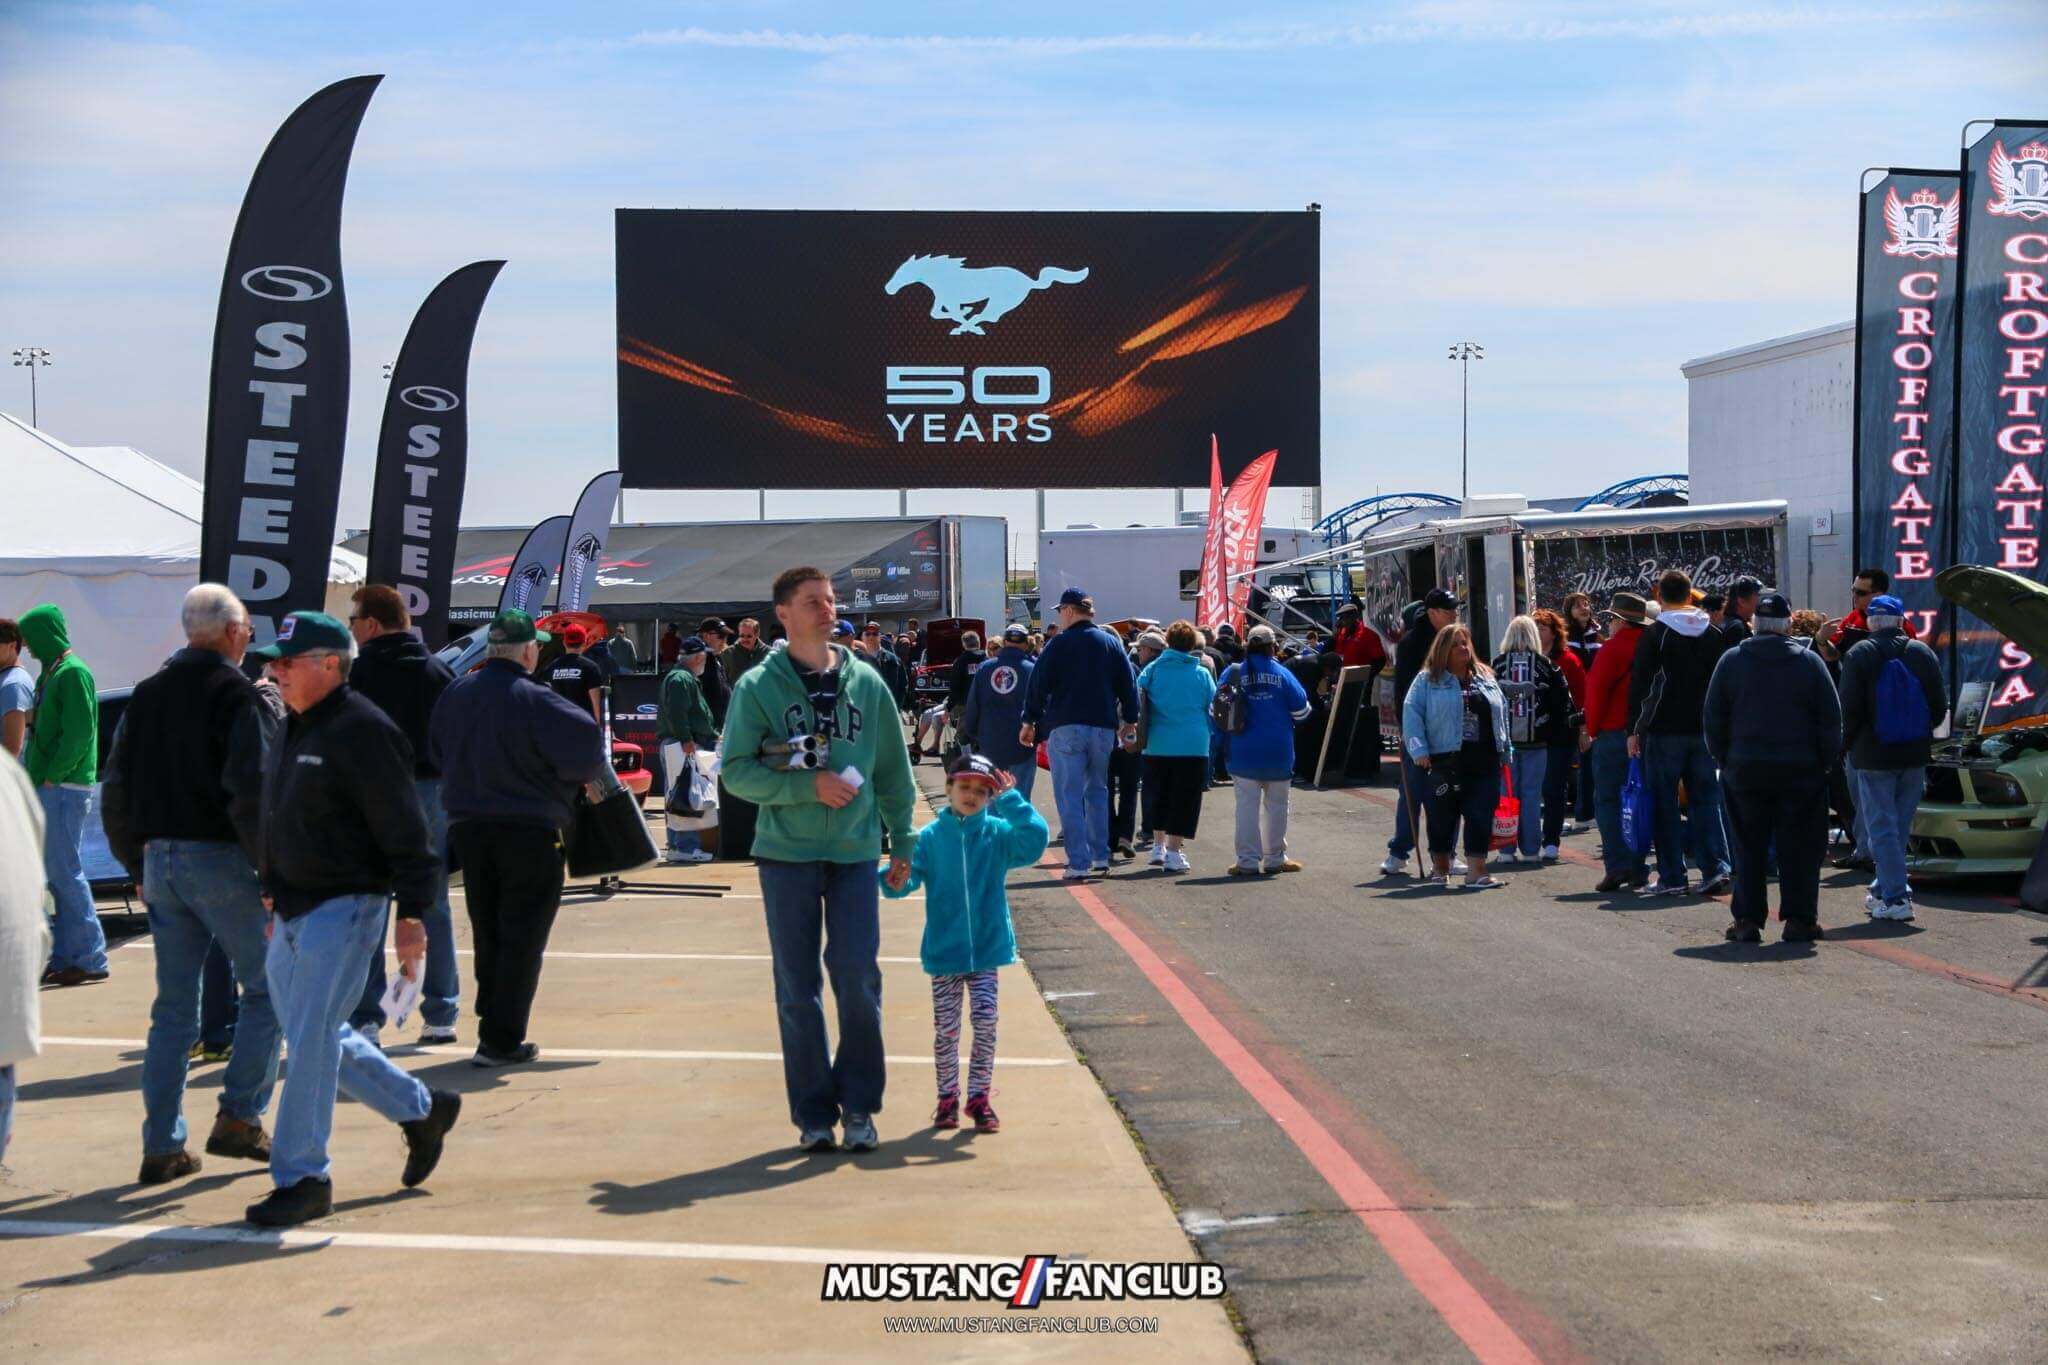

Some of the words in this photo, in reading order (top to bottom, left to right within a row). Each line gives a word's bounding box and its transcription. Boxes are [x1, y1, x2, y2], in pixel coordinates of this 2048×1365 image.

[886, 366, 1051, 405] 50
[1996, 233, 2048, 569] CROFTGATE
[886, 413, 1052, 443] YEARS
[1890, 271, 1937, 580] CROFTGATE
[1574, 567, 1633, 595] Where
[1991, 641, 2035, 707] SA
[615, 713, 657, 721] STEE
